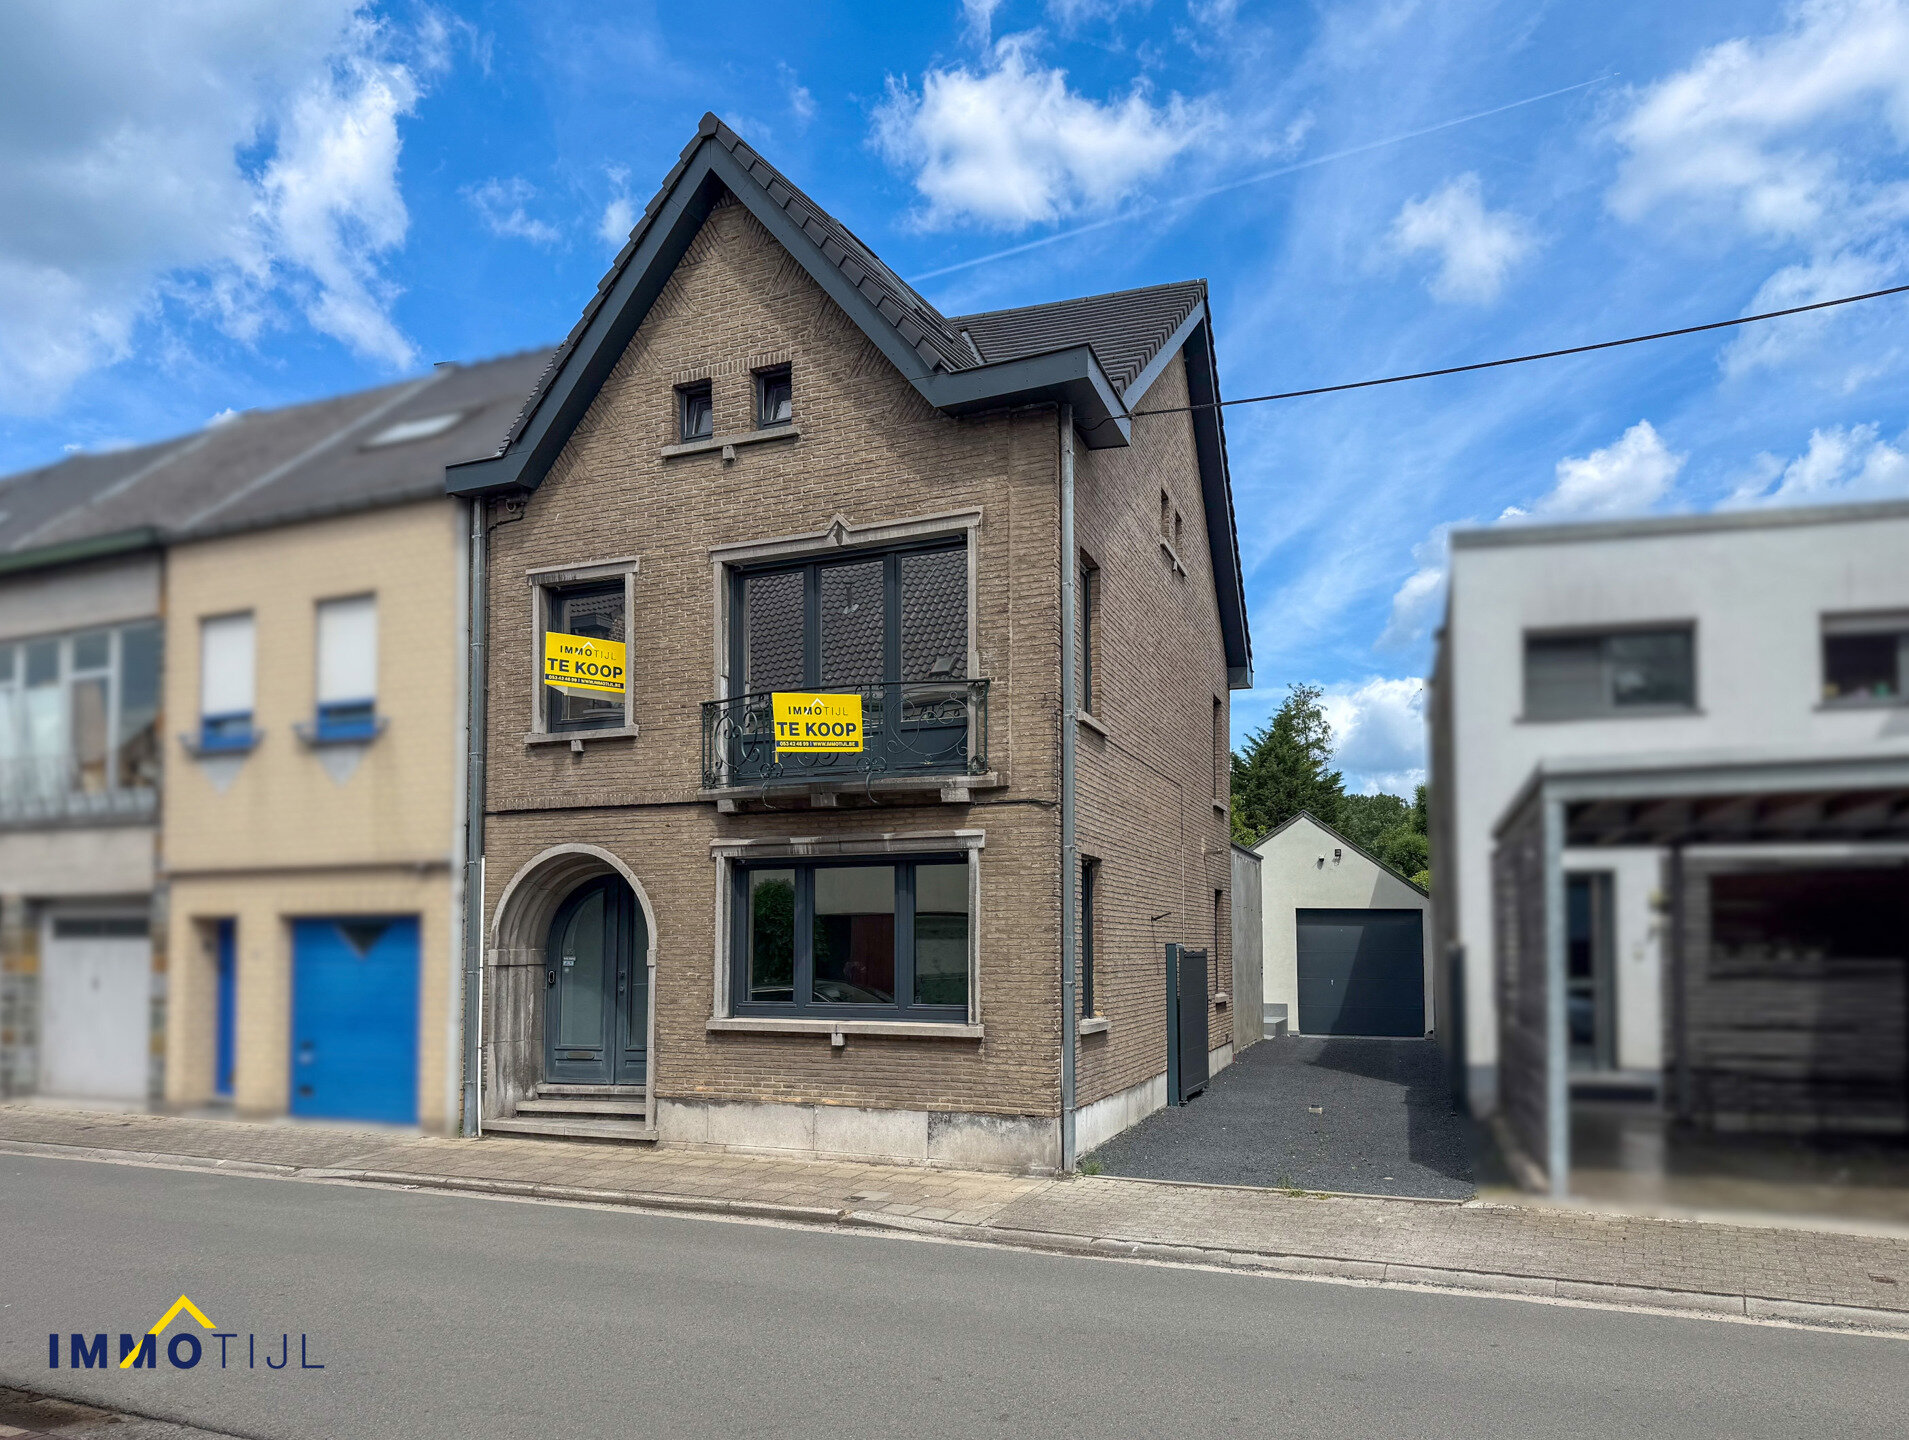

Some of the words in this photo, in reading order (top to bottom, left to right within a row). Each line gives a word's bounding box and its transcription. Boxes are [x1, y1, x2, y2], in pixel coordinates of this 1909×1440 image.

[560, 646, 616, 660] IMMOTIJL
[547, 658, 570, 672] TE
[576, 661, 622, 678] KOOP
[788, 706, 848, 715] IMMOTIJL
[776, 722, 800, 736] TE
[806, 722, 856, 736] KOOP
